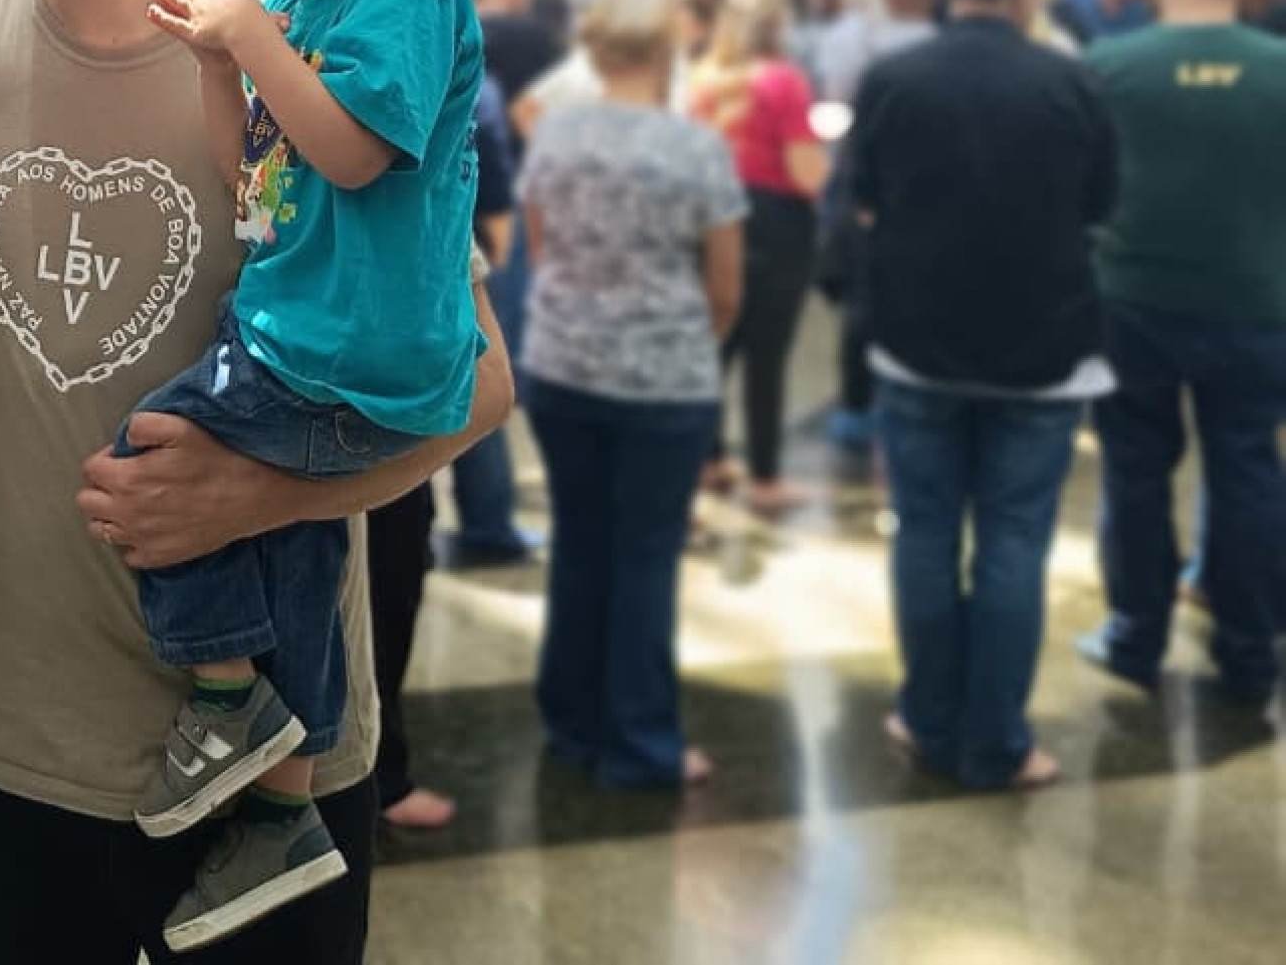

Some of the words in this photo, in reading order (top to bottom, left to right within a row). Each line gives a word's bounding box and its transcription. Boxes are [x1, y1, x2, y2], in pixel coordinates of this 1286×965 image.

[17, 164, 56, 184] AOS
[60, 176, 146, 202] HOMENS
[150, 185, 176, 213] DE
[163, 219, 184, 264] BOA
[9, 292, 42, 330] PAZ
[98, 273, 175, 355] VONTADE
